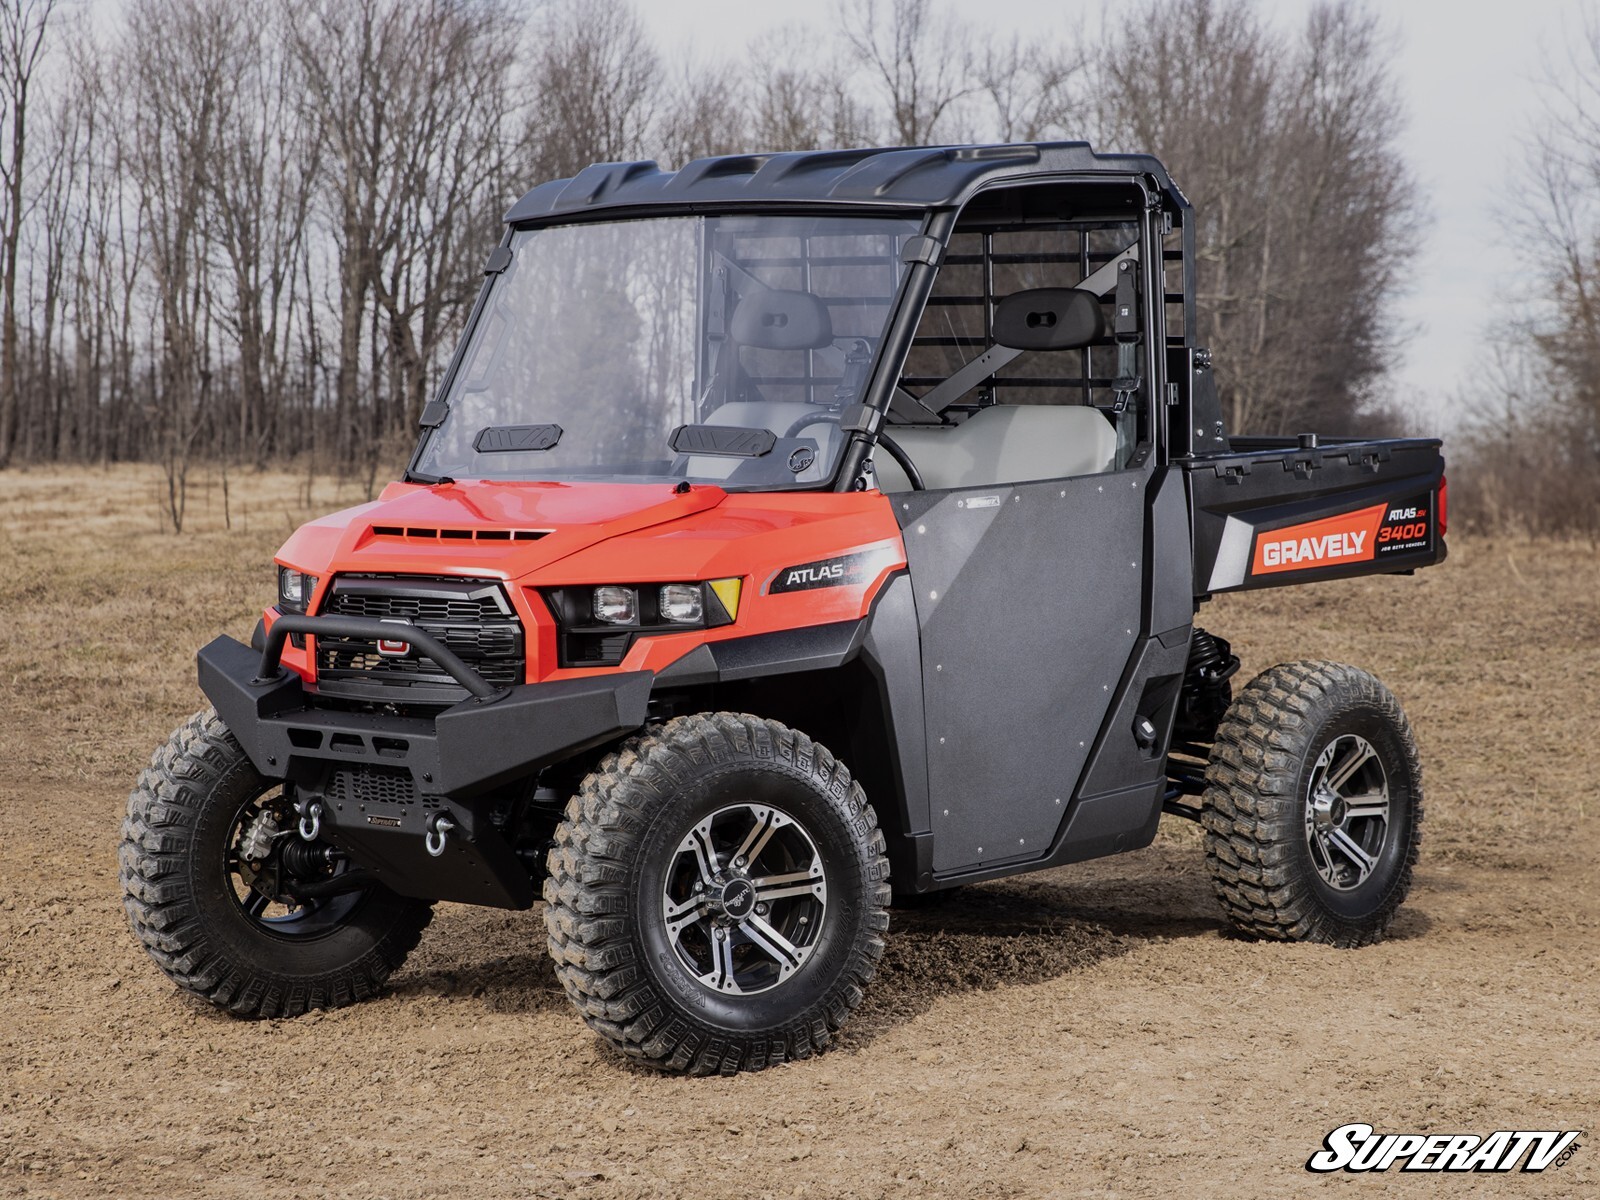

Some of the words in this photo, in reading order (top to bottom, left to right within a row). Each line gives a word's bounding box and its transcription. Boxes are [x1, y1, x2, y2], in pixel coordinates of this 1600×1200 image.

[1388, 507, 1417, 521] ATLAS
[1378, 522, 1427, 542] 3400
[1263, 531, 1366, 566] GRAVELY
[786, 564, 843, 585] ATLAS
[659, 948, 706, 1008] WARRIOR
